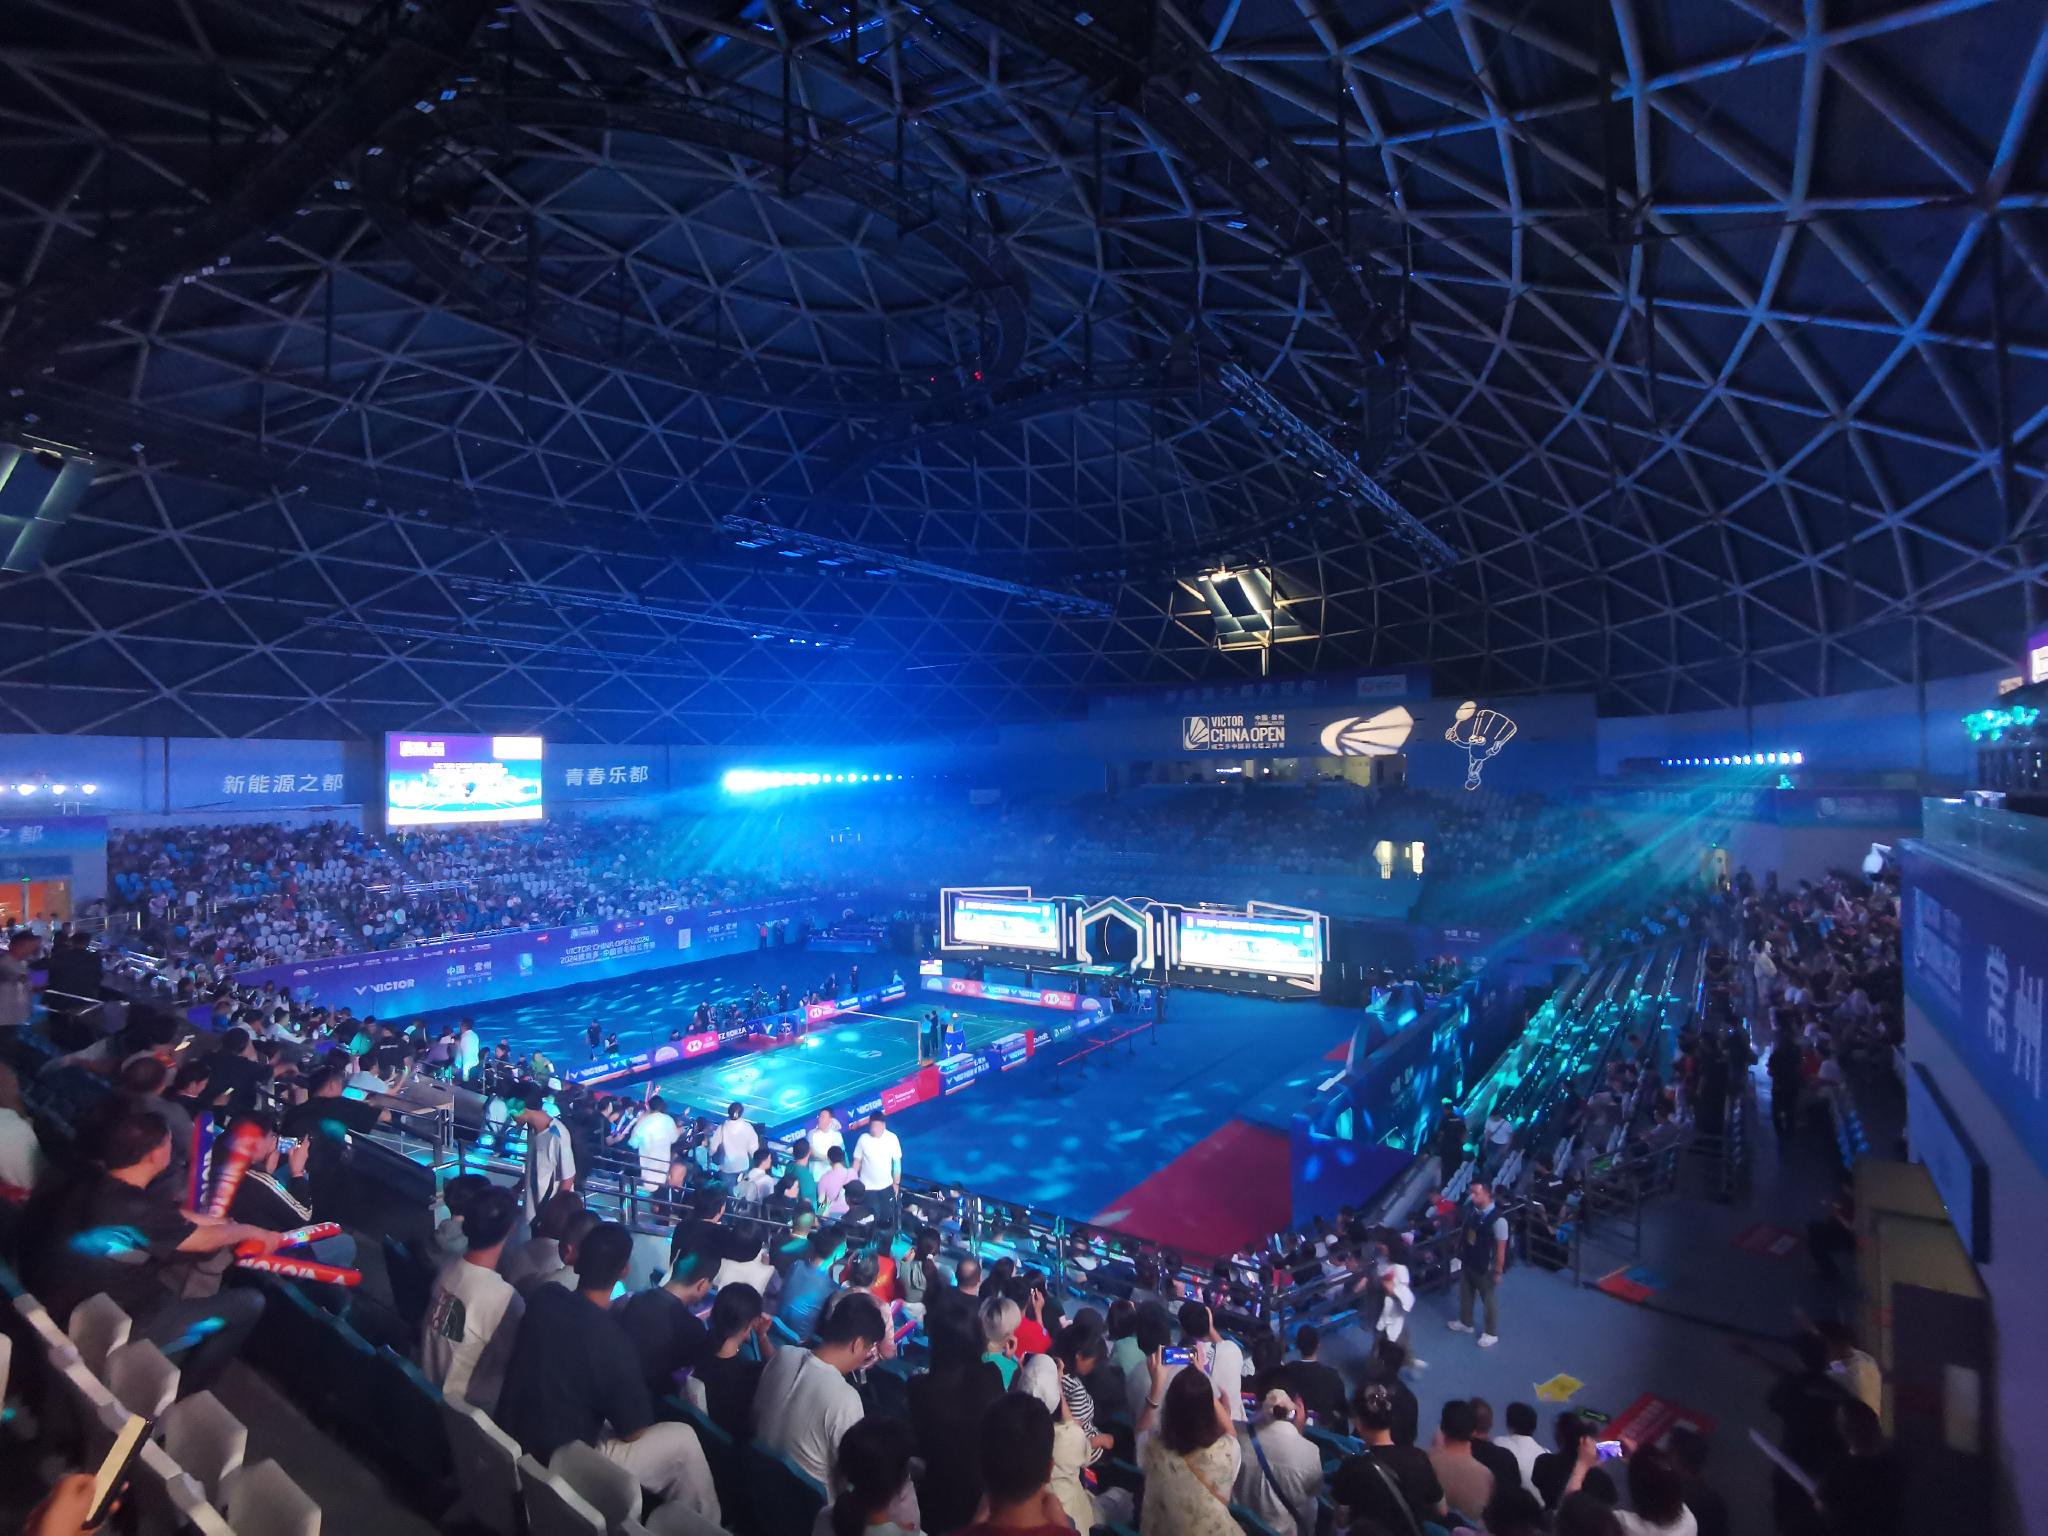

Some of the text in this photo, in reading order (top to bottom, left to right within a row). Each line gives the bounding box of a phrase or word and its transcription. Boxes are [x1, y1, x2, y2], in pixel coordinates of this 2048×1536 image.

[1211, 716, 1244, 727] VICTOR
[1210, 726, 1285, 743] CHINA OPEN
[222, 773, 345, 794] 新能源之都
[565, 765, 649, 787] 青春乐都
[566, 945, 592, 955] VICTOR
[369, 978, 415, 993] VICTOR
[857, 1099, 882, 1115] VICTOR
